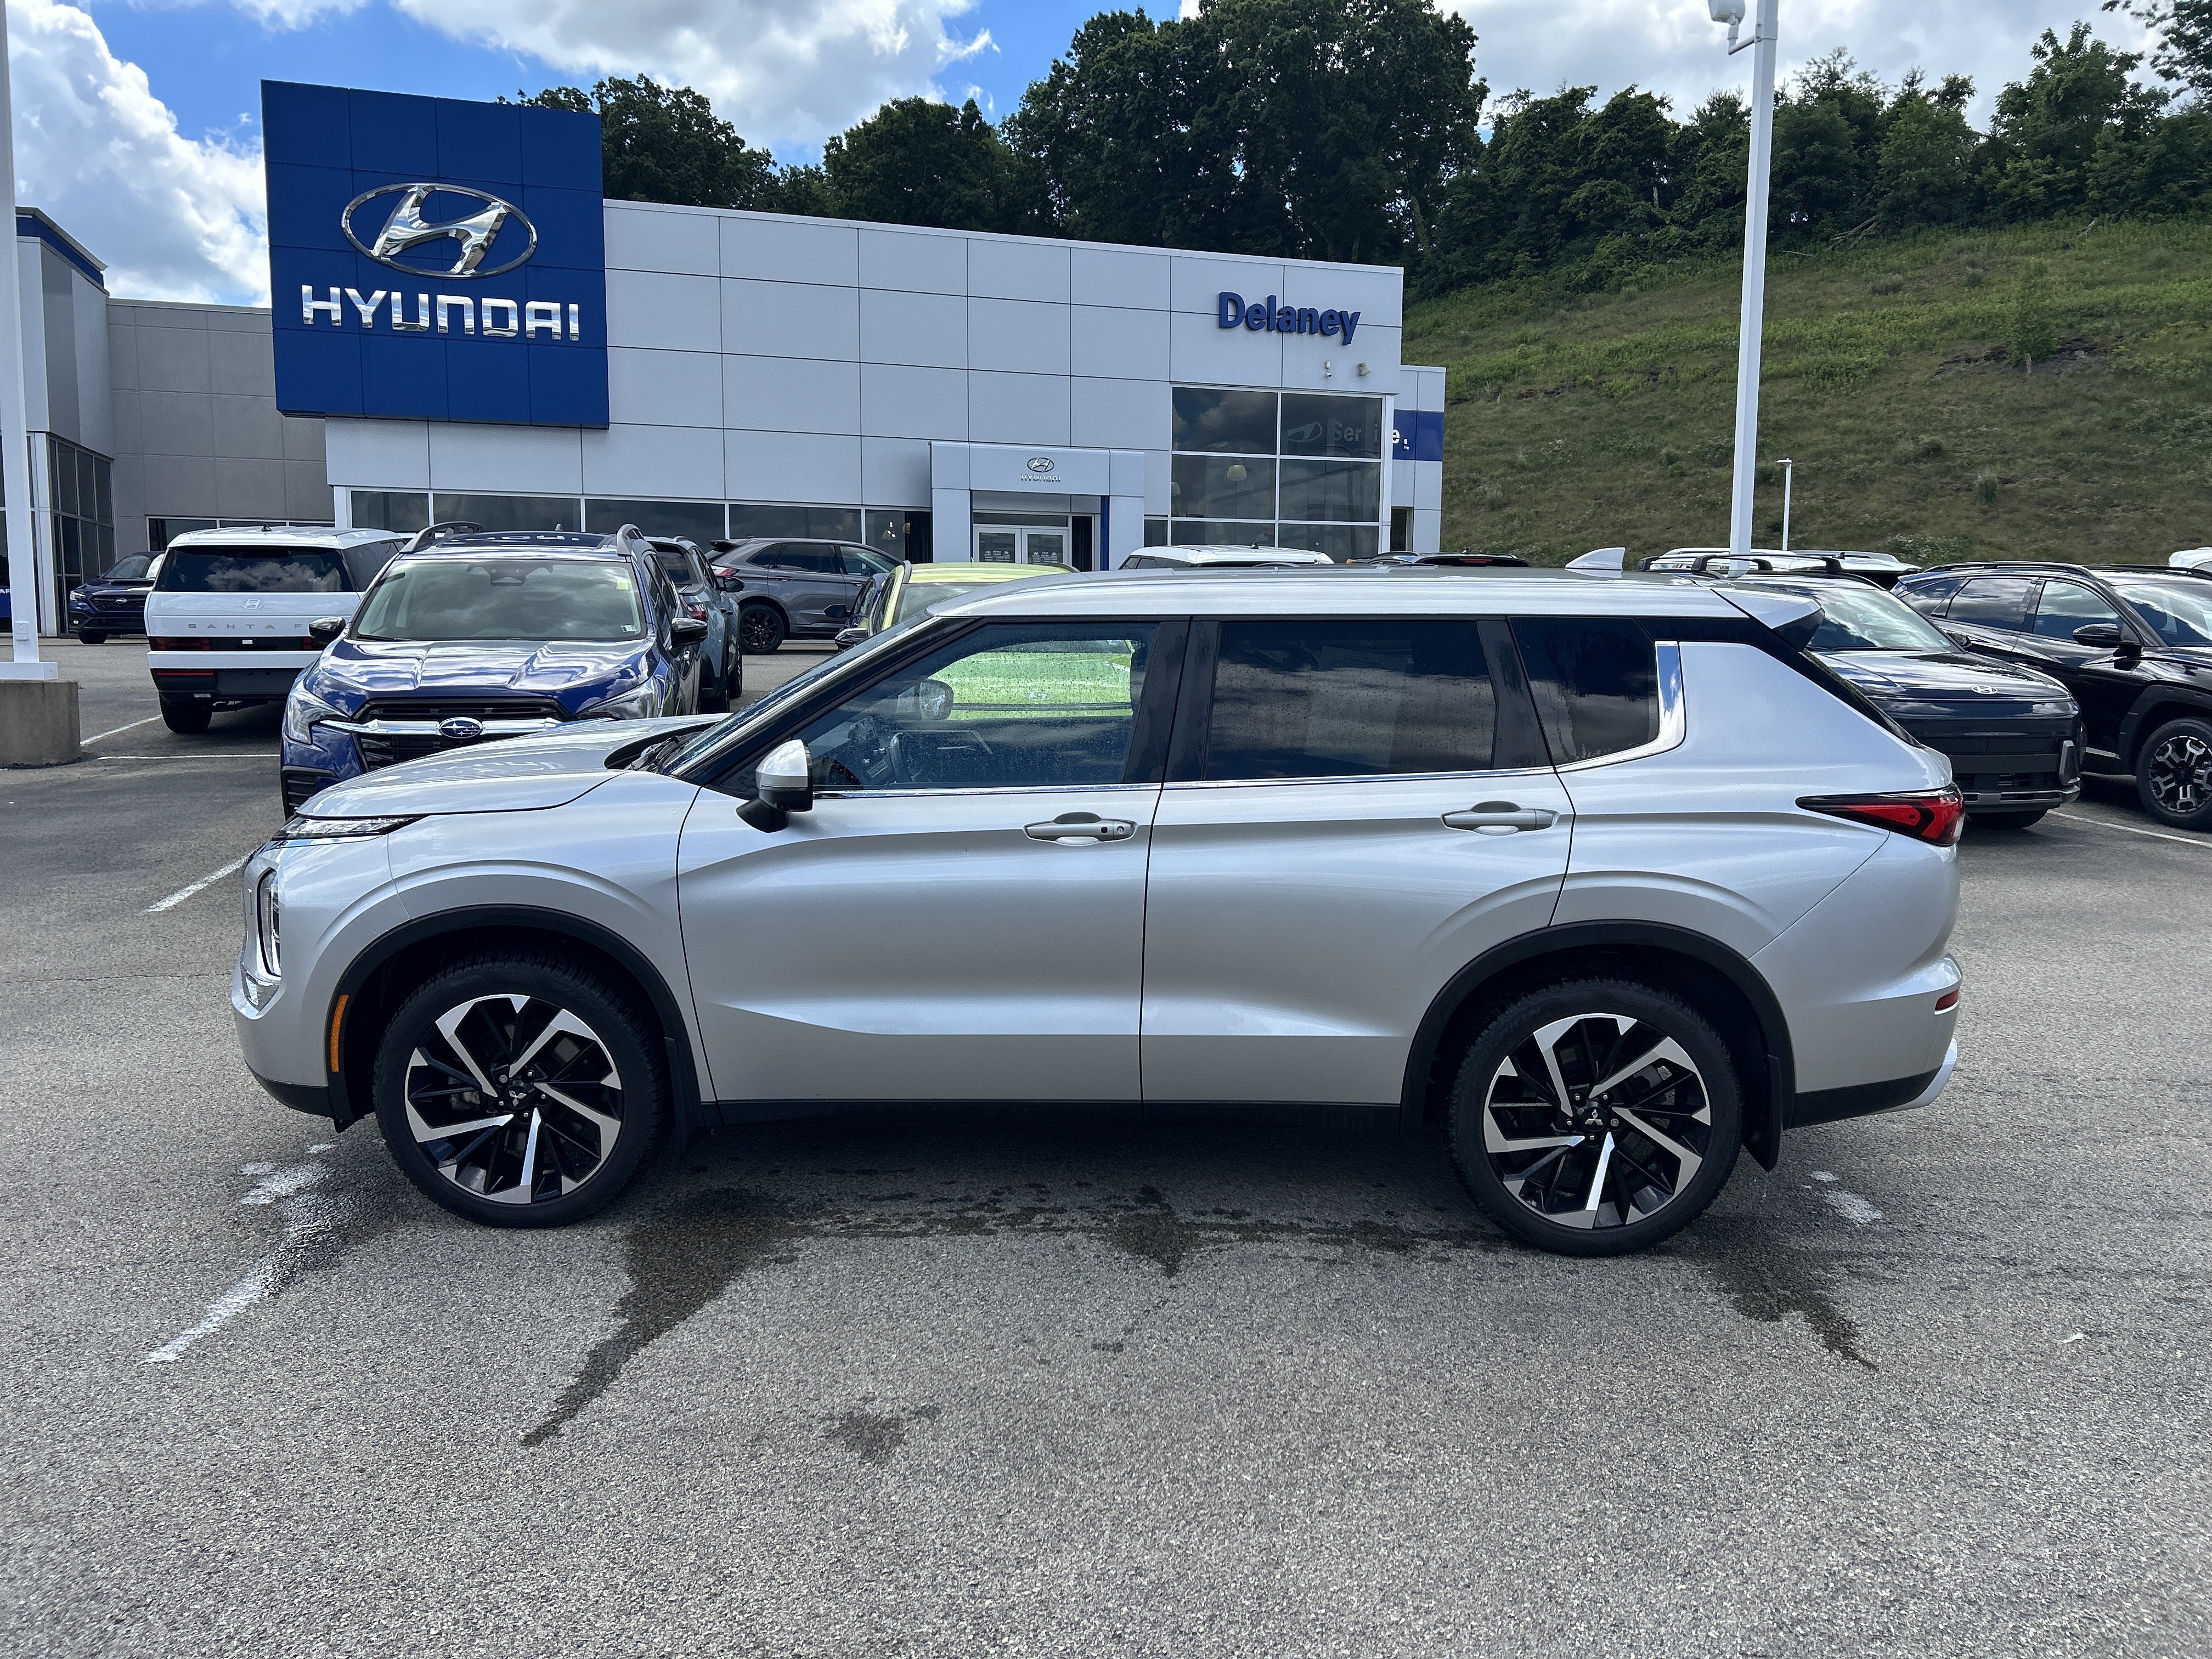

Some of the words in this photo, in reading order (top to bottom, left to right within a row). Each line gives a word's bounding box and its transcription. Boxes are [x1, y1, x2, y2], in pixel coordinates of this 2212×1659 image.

[301, 284, 579, 341] HYUNDAI
[1218, 291, 1361, 346] Delaney
[1021, 473, 1060, 483] HYUNDAI
